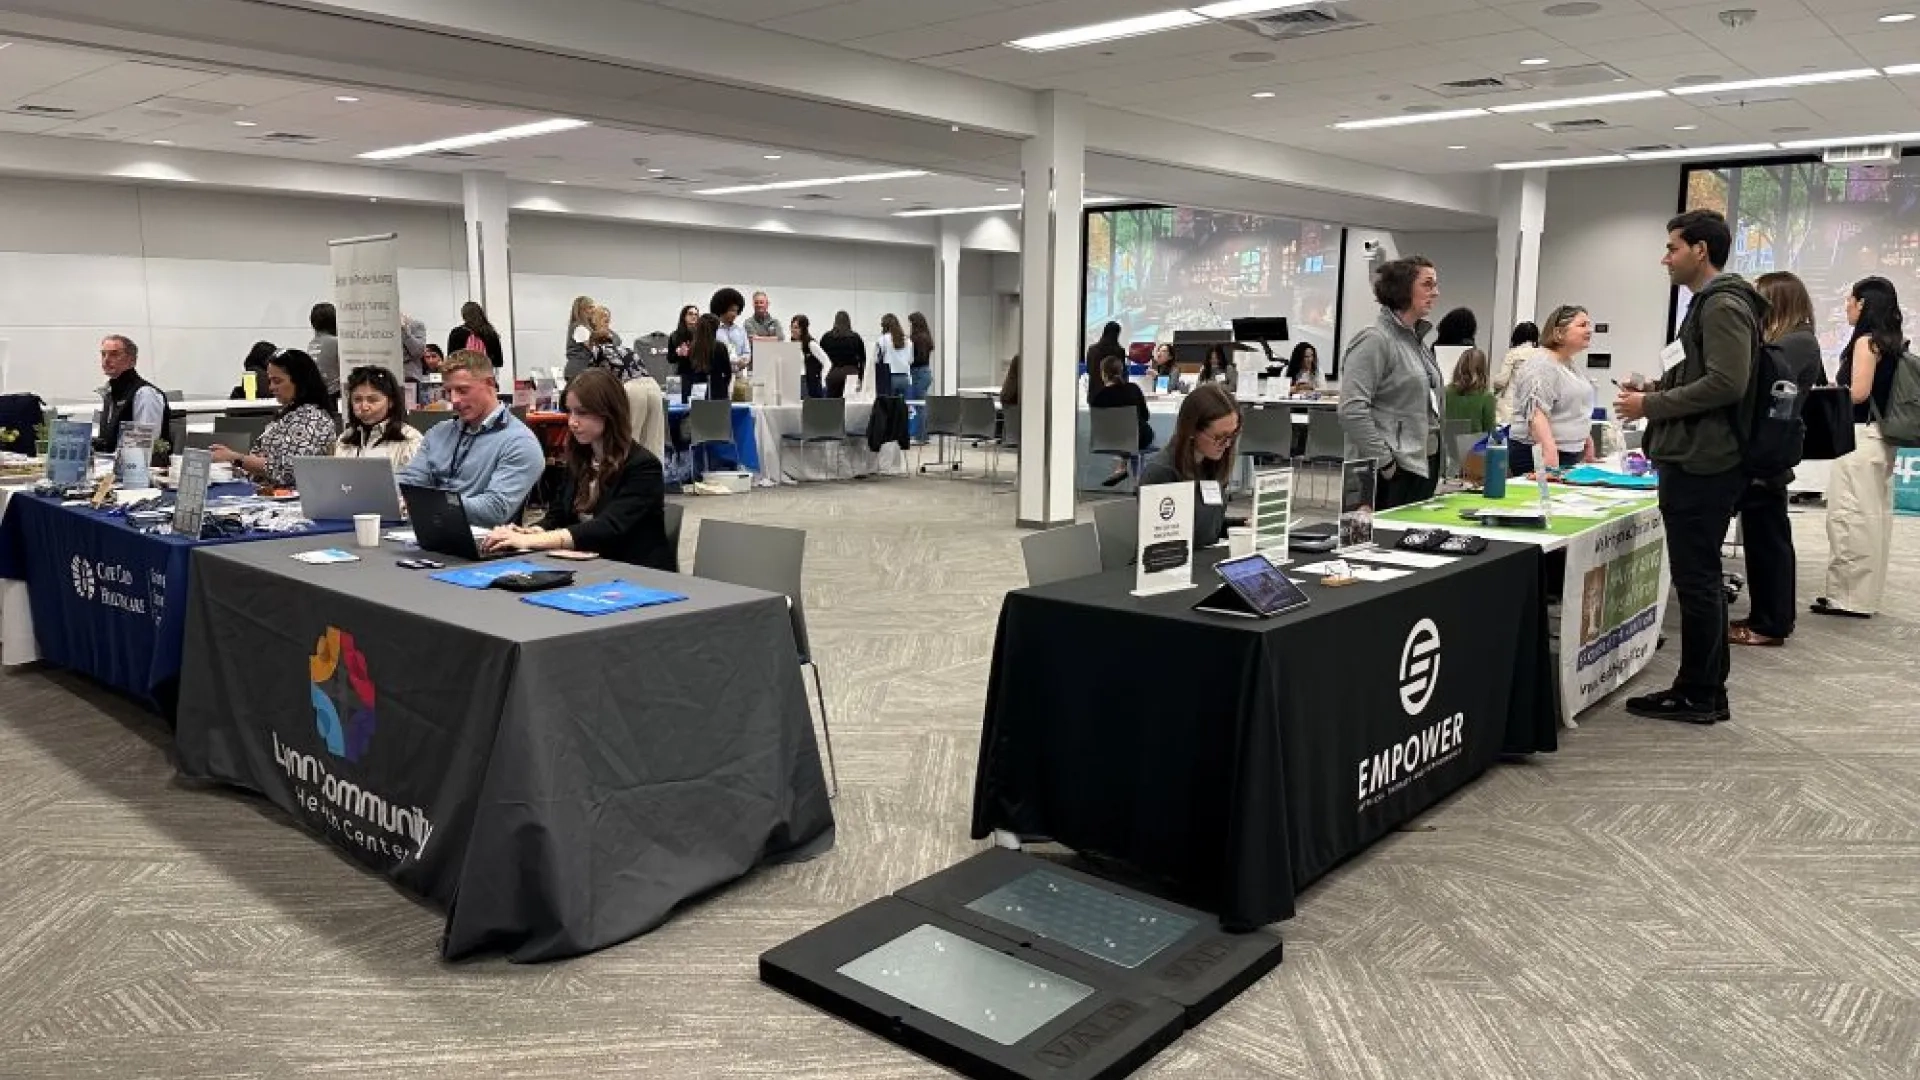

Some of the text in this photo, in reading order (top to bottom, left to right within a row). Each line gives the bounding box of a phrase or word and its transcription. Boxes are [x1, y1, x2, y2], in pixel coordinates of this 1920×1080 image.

[272, 731, 318, 784] Lynn
[1359, 712, 1464, 800] EMPOWER
[343, 819, 409, 863] Center
[1040, 1002, 1135, 1060] VALD
